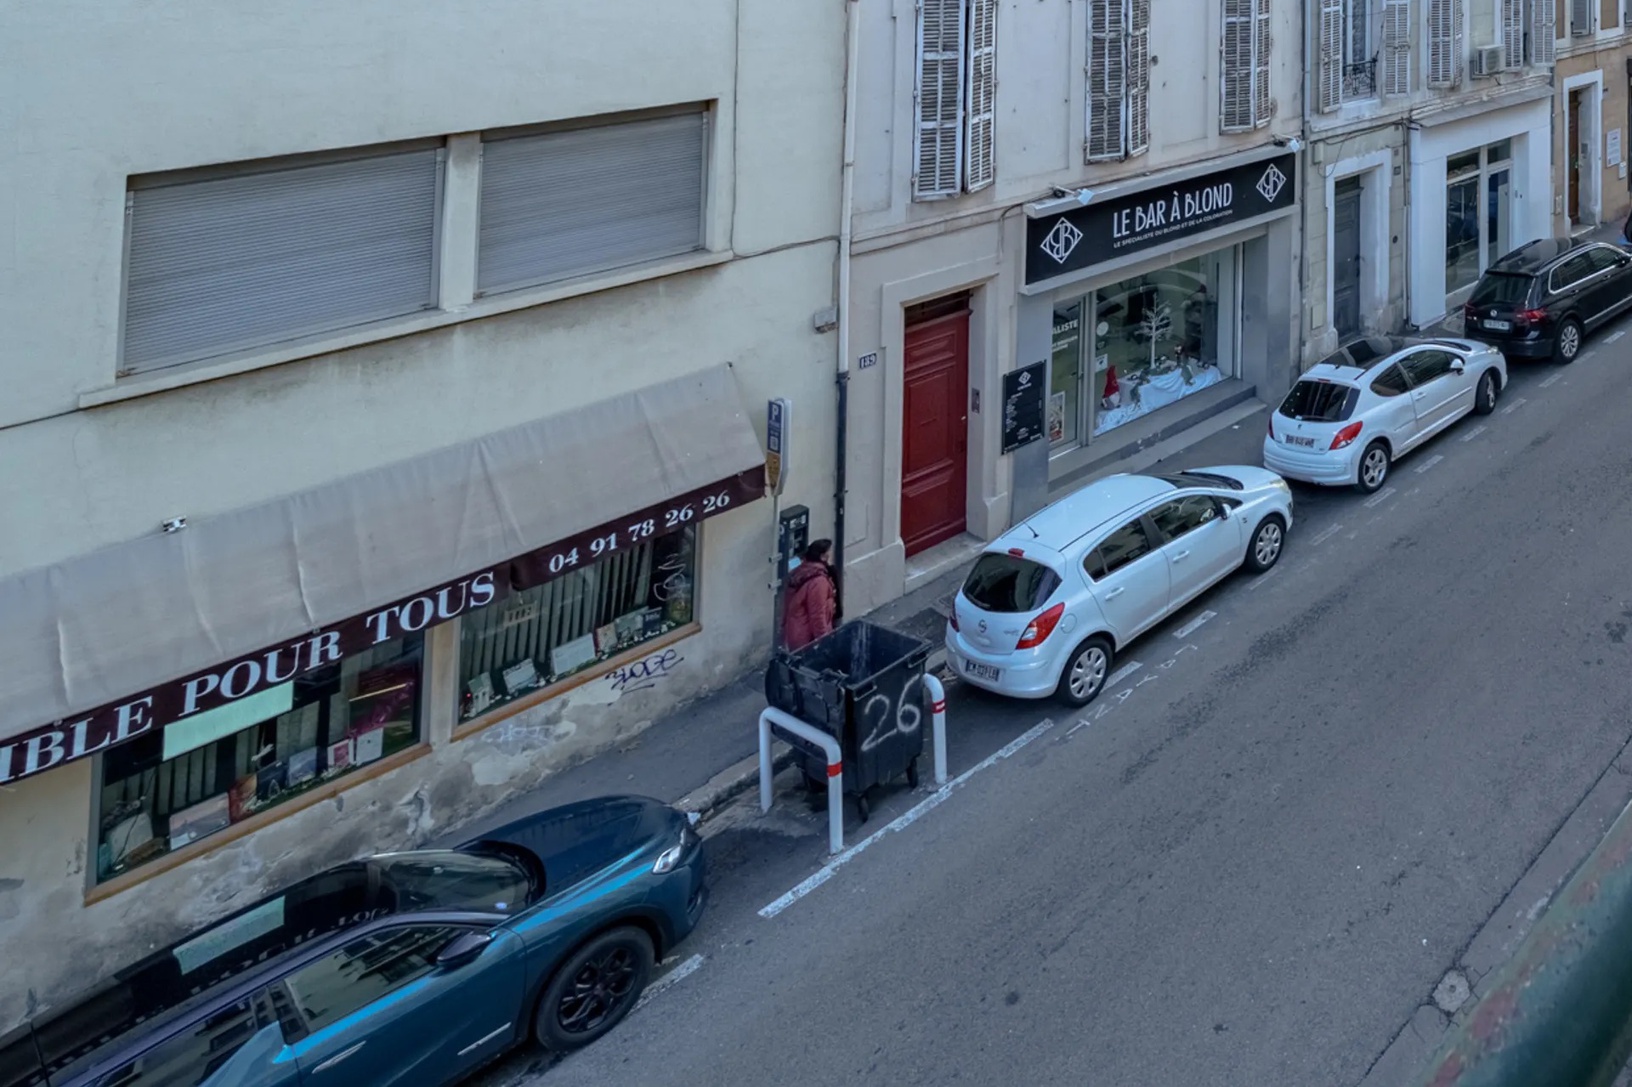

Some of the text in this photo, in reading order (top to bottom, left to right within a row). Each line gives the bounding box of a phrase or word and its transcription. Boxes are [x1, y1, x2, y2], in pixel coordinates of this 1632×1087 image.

[1113, 183, 1232, 238] LE BAR À BLOND
[549, 490, 730, 572] 04 91 78 26 26
[178, 631, 343, 716] POUR
[366, 572, 495, 644] TOUS
[861, 673, 920, 751] 26
